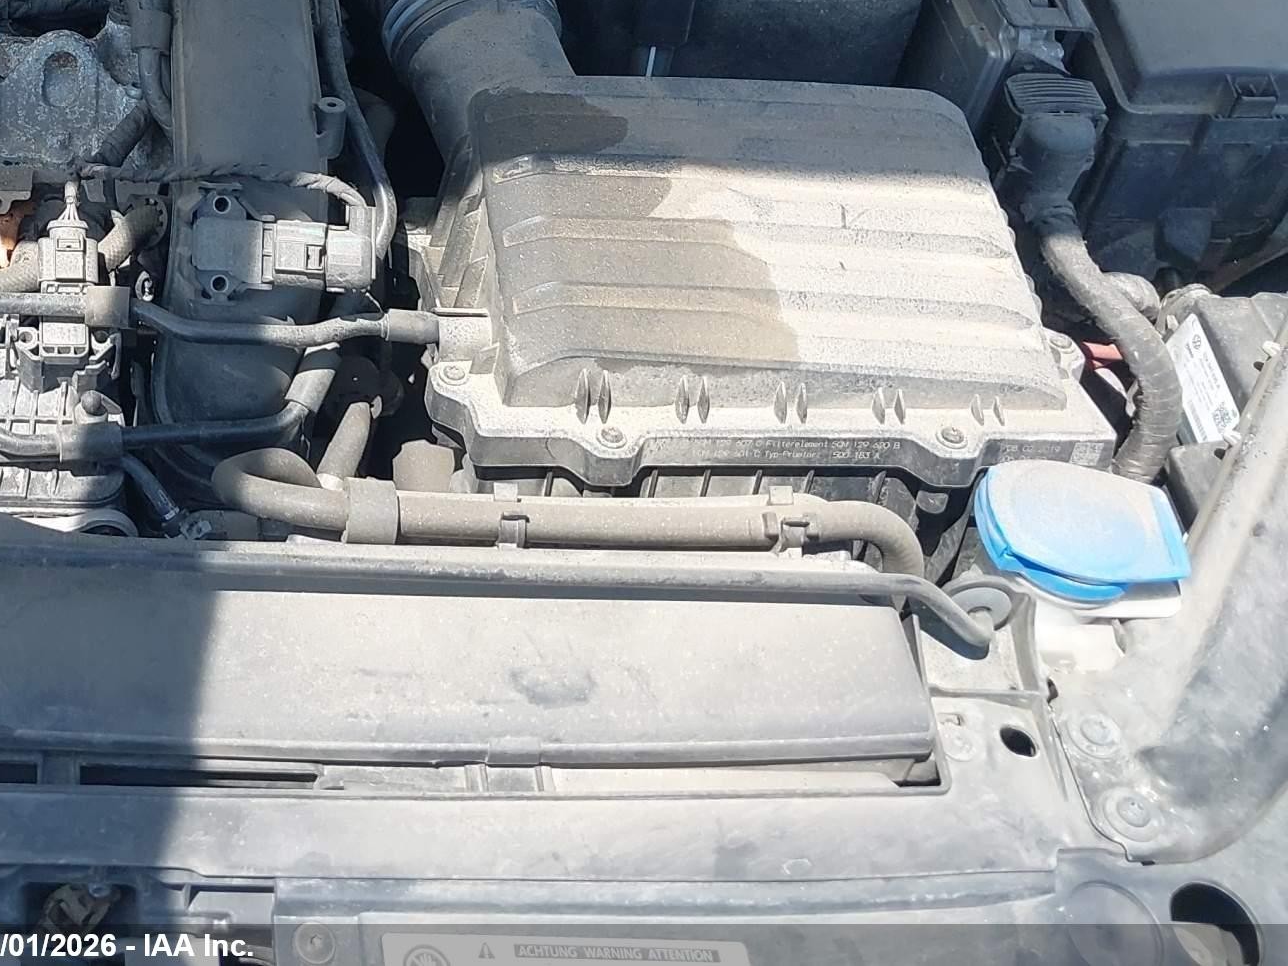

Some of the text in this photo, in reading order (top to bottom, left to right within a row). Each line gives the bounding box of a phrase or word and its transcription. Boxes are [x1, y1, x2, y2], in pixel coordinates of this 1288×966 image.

[517, 944, 714, 961] ACHTUNG WARNING ATTENTION
